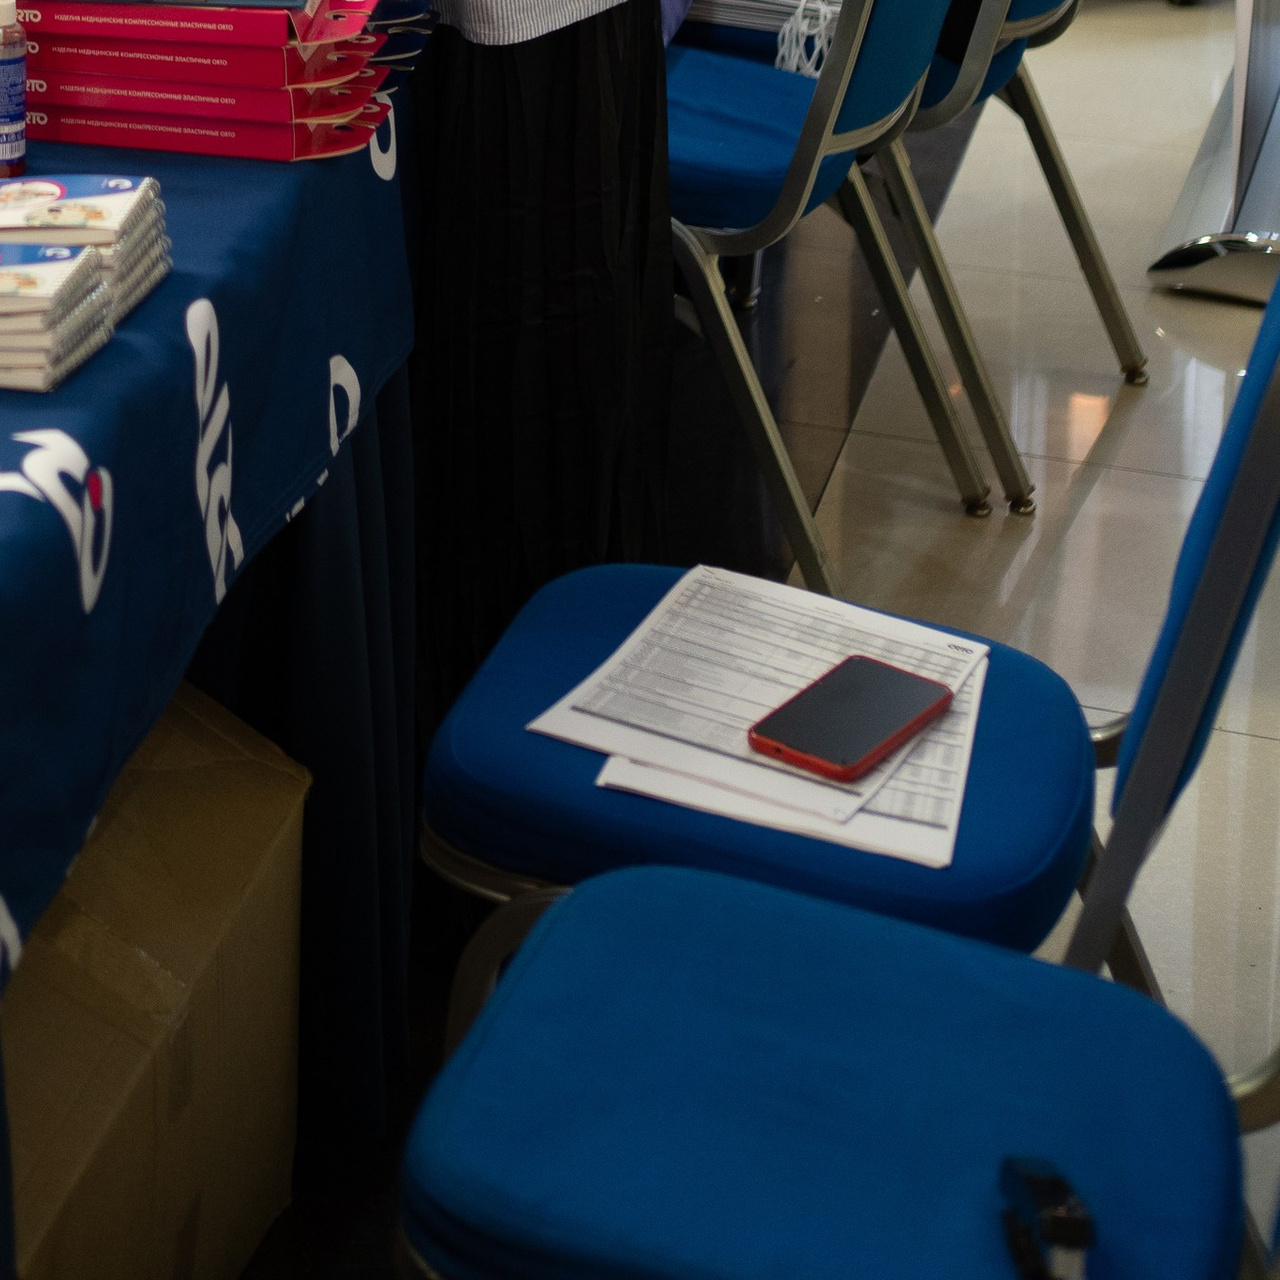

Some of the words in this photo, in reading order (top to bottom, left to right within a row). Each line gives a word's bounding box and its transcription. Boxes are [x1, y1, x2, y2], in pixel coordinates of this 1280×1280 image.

[16, 9, 42, 23] RTO
[54, 13, 80, 22] ИЗДЕЛИЯ
[81, 15, 123, 25] МЕДИЦИНСКИЕ
[124, 18, 179, 28] КОМПРЕССИОННЫЕ
[179, 21, 217, 31] ЭЛАСТИЧНЫЕ
[120, 51, 174, 62] КОМПРЕССИОННЫЕ
[26, 79, 48, 92] RTO
[128, 90, 182, 100] КОМПРЕССИОННЫЕ
[26, 112, 48, 125] RTO
[128, 123, 182, 134] КОМПРЕССИОННЫЕ
